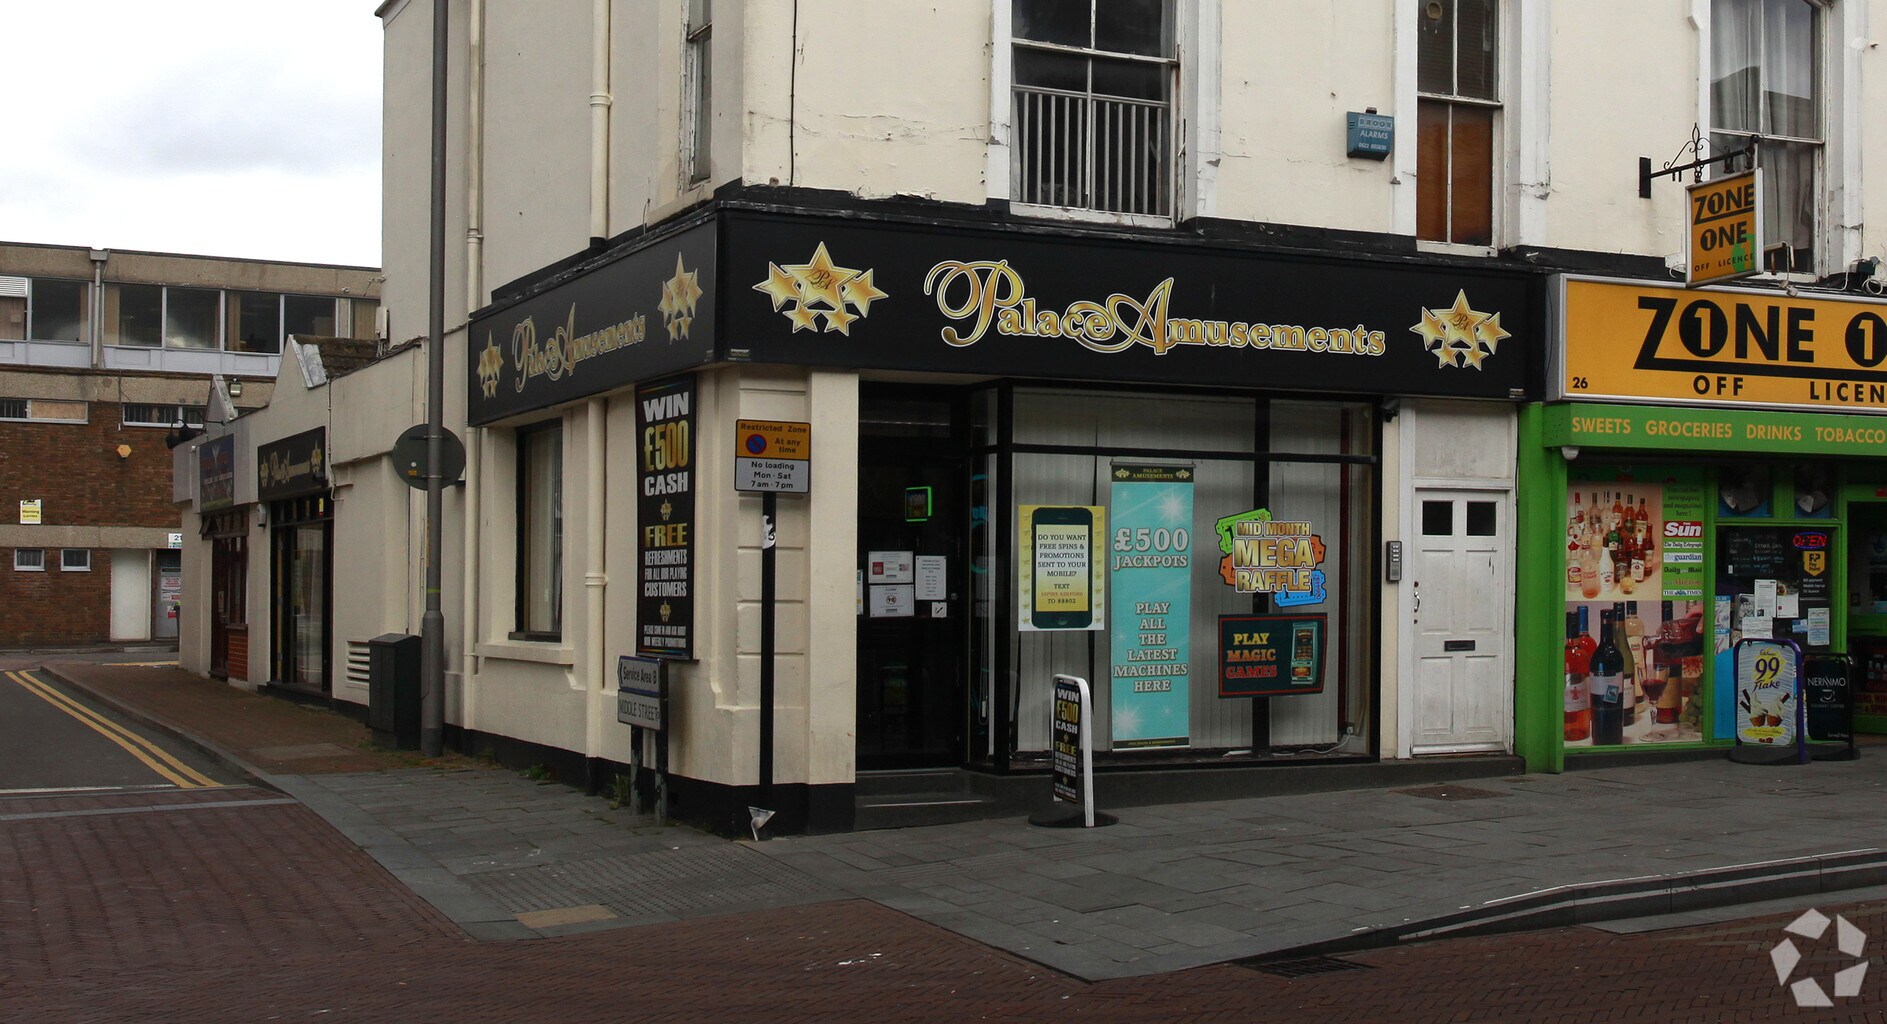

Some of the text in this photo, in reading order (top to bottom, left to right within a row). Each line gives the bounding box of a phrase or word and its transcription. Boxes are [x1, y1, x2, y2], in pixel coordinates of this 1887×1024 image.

[1360, 130, 1388, 140] ALARMS
[1693, 183, 1755, 225] ZONE
[1700, 221, 1747, 251] ONE
[1694, 263, 1710, 272] OFF
[923, 259, 1387, 356] Palace Amusements
[1633, 296, 1815, 373] ZONE
[1572, 377, 1589, 389] 26
[1693, 375, 1744, 396] OFF
[643, 392, 689, 423] WIN
[740, 423, 807, 433] Restricted Zone
[1571, 417, 1886, 443] SWEETS GROCERIES DRINKS TOBACCO
[644, 420, 689, 473] £500
[765, 462, 795, 470] loading
[753, 471, 771, 479] Mon
[644, 471, 689, 497] CASH
[645, 523, 688, 548] FREE
[1237, 521, 1311, 536] MID MONTH
[1664, 522, 1702, 536] Sun
[1113, 527, 1189, 552] £500
[645, 549, 688, 565] REFRESHMENTS
[1233, 538, 1316, 568] MEGA
[1113, 555, 1188, 571] JACKPOTS
[1235, 569, 1312, 593] RAFFLE
[645, 581, 687, 597] CUSTOMERS
[1135, 602, 1171, 614] PLAY
[1139, 618, 1166, 630] ALL
[1138, 633, 1166, 646] THE
[1233, 632, 1270, 646] PLAY
[1127, 648, 1178, 662] LATEST
[1226, 649, 1276, 662] MAGIC
[623, 666, 640, 681] Service
[640, 669, 652, 683] Area
[1113, 663, 1188, 678] MACHINES
[1225, 665, 1278, 679] GAMES
[1755, 657, 1780, 681] 99
[1134, 680, 1171, 693] HERE
[1753, 680, 1781, 693] Flake
[1057, 688, 1080, 703] WIN
[620, 699, 637, 717] MIDDLE
[639, 703, 659, 722] STREET
[1056, 700, 1079, 723] £500
[1055, 719, 1077, 734] CASH
[1055, 740, 1077, 755] FREE
